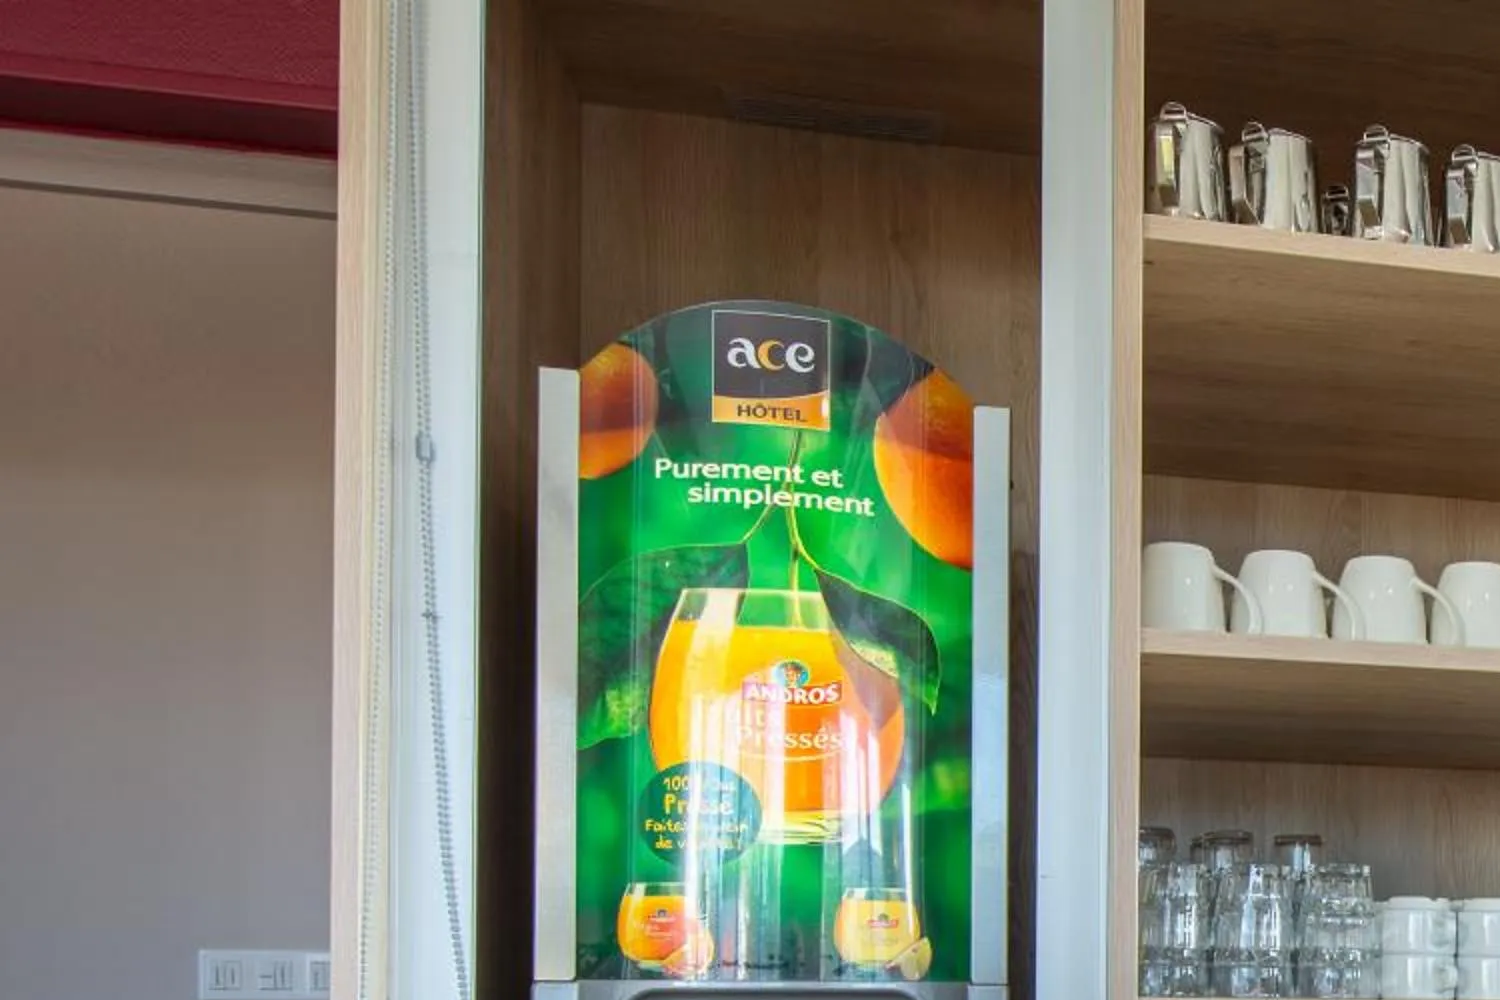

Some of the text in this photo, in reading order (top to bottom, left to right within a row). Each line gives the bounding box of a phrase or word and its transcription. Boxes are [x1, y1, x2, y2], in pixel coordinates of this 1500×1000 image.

[727, 337, 815, 373] ace
[737, 402, 808, 423] HÔTEL
[655, 457, 844, 488] Purement et
[687, 482, 875, 517] simplement
[747, 683, 840, 704] ANDROS
